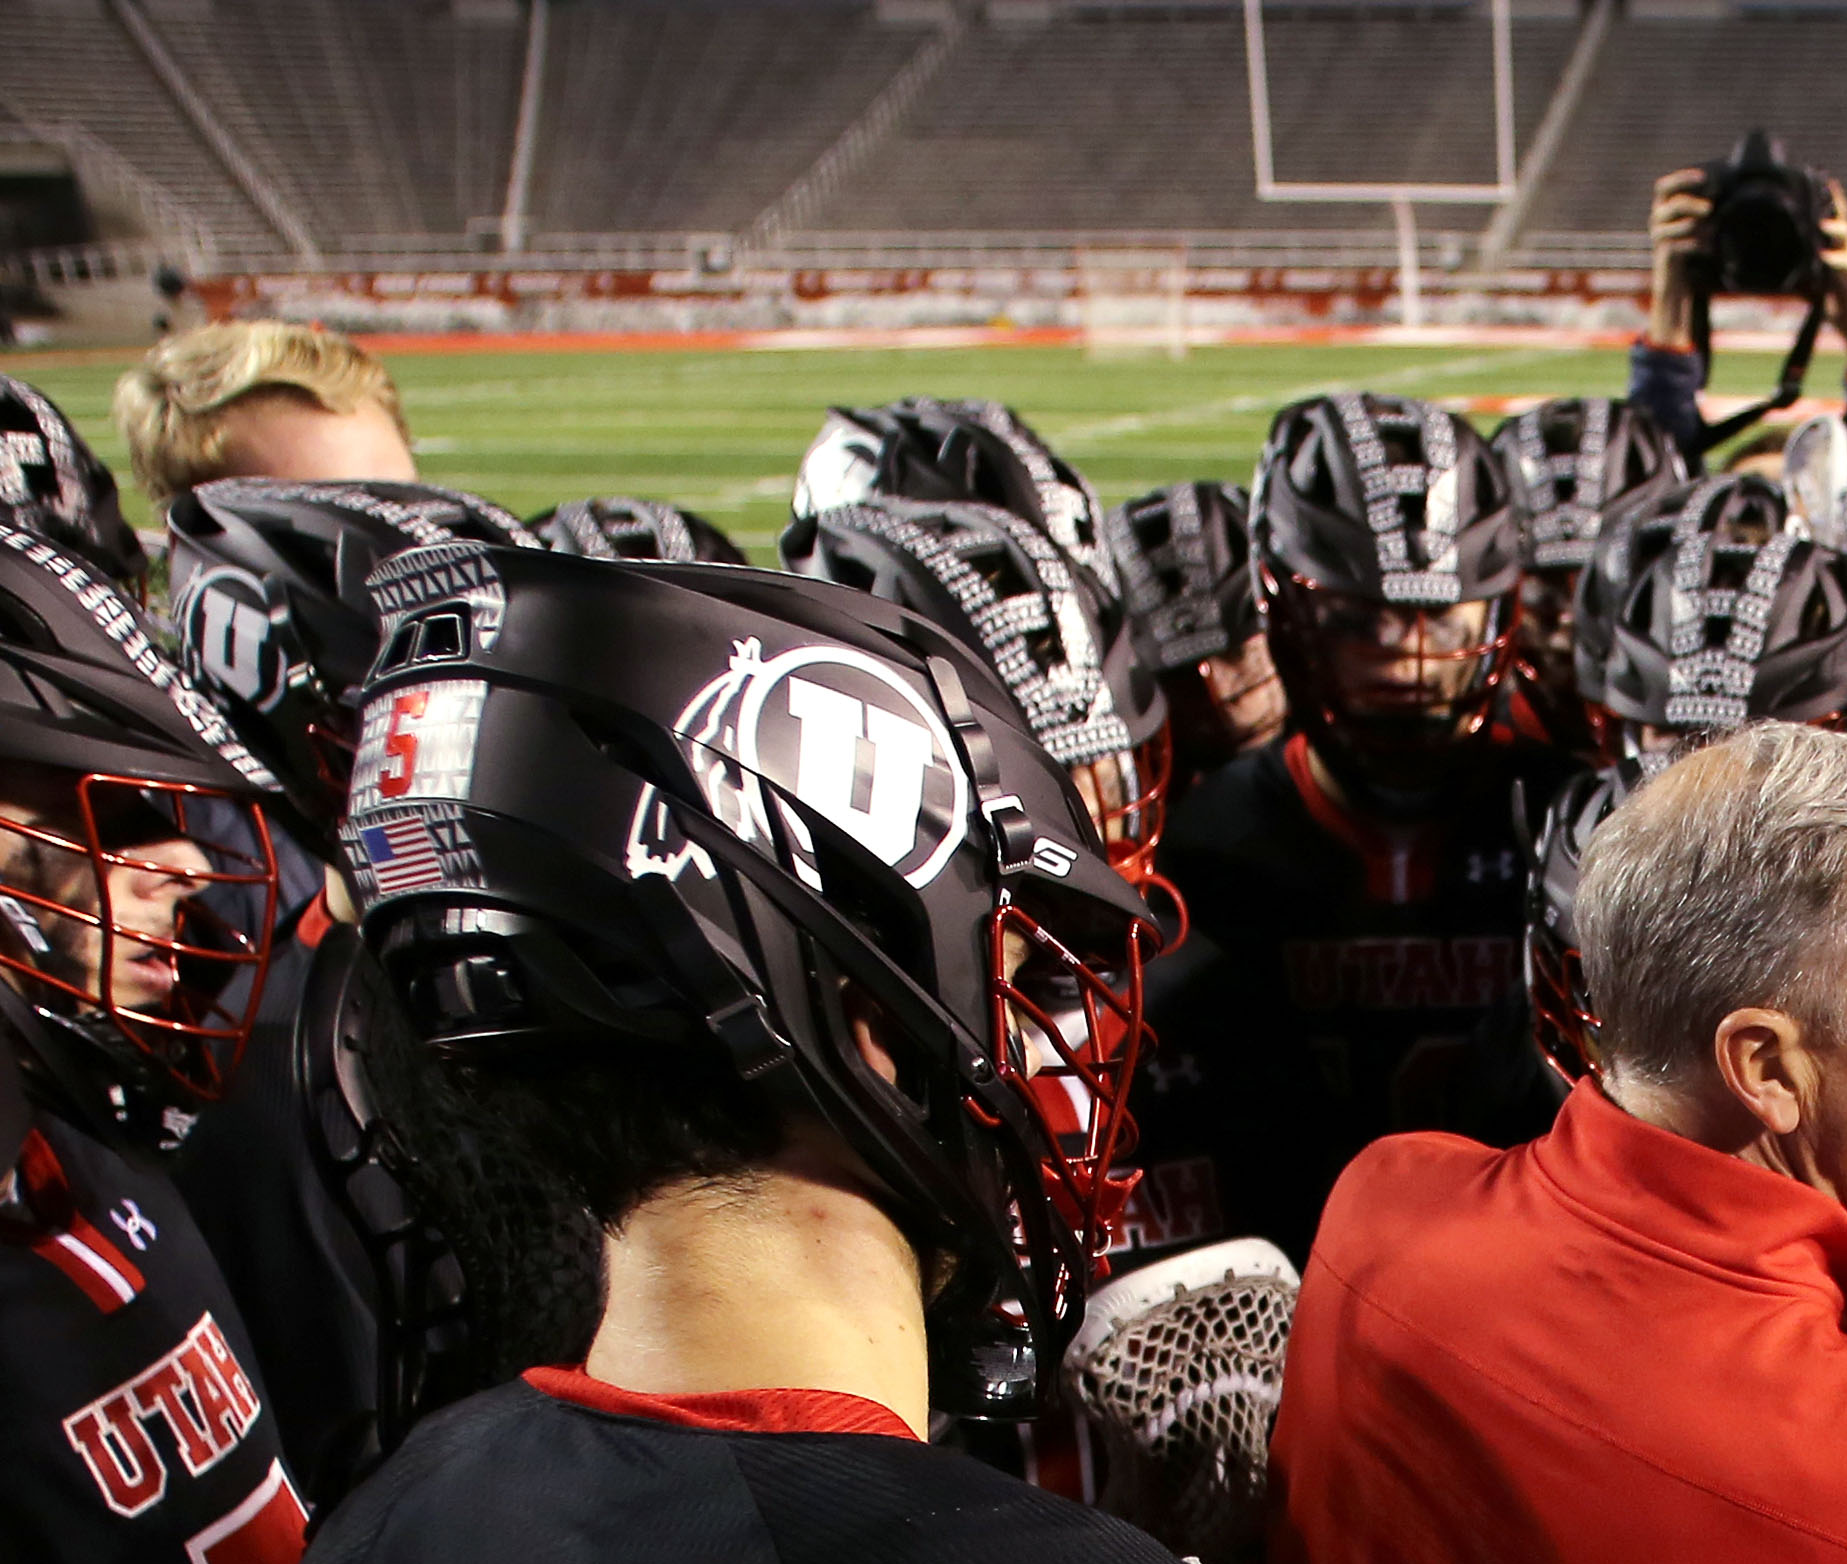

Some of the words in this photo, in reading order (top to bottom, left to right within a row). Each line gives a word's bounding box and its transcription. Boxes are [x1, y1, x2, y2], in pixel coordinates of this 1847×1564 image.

[199, 592, 270, 700] U
[377, 690, 428, 799] 5
[787, 676, 935, 868] U
[1281, 935, 1516, 1010] UTAH
[62, 1310, 263, 1519] UTAH
